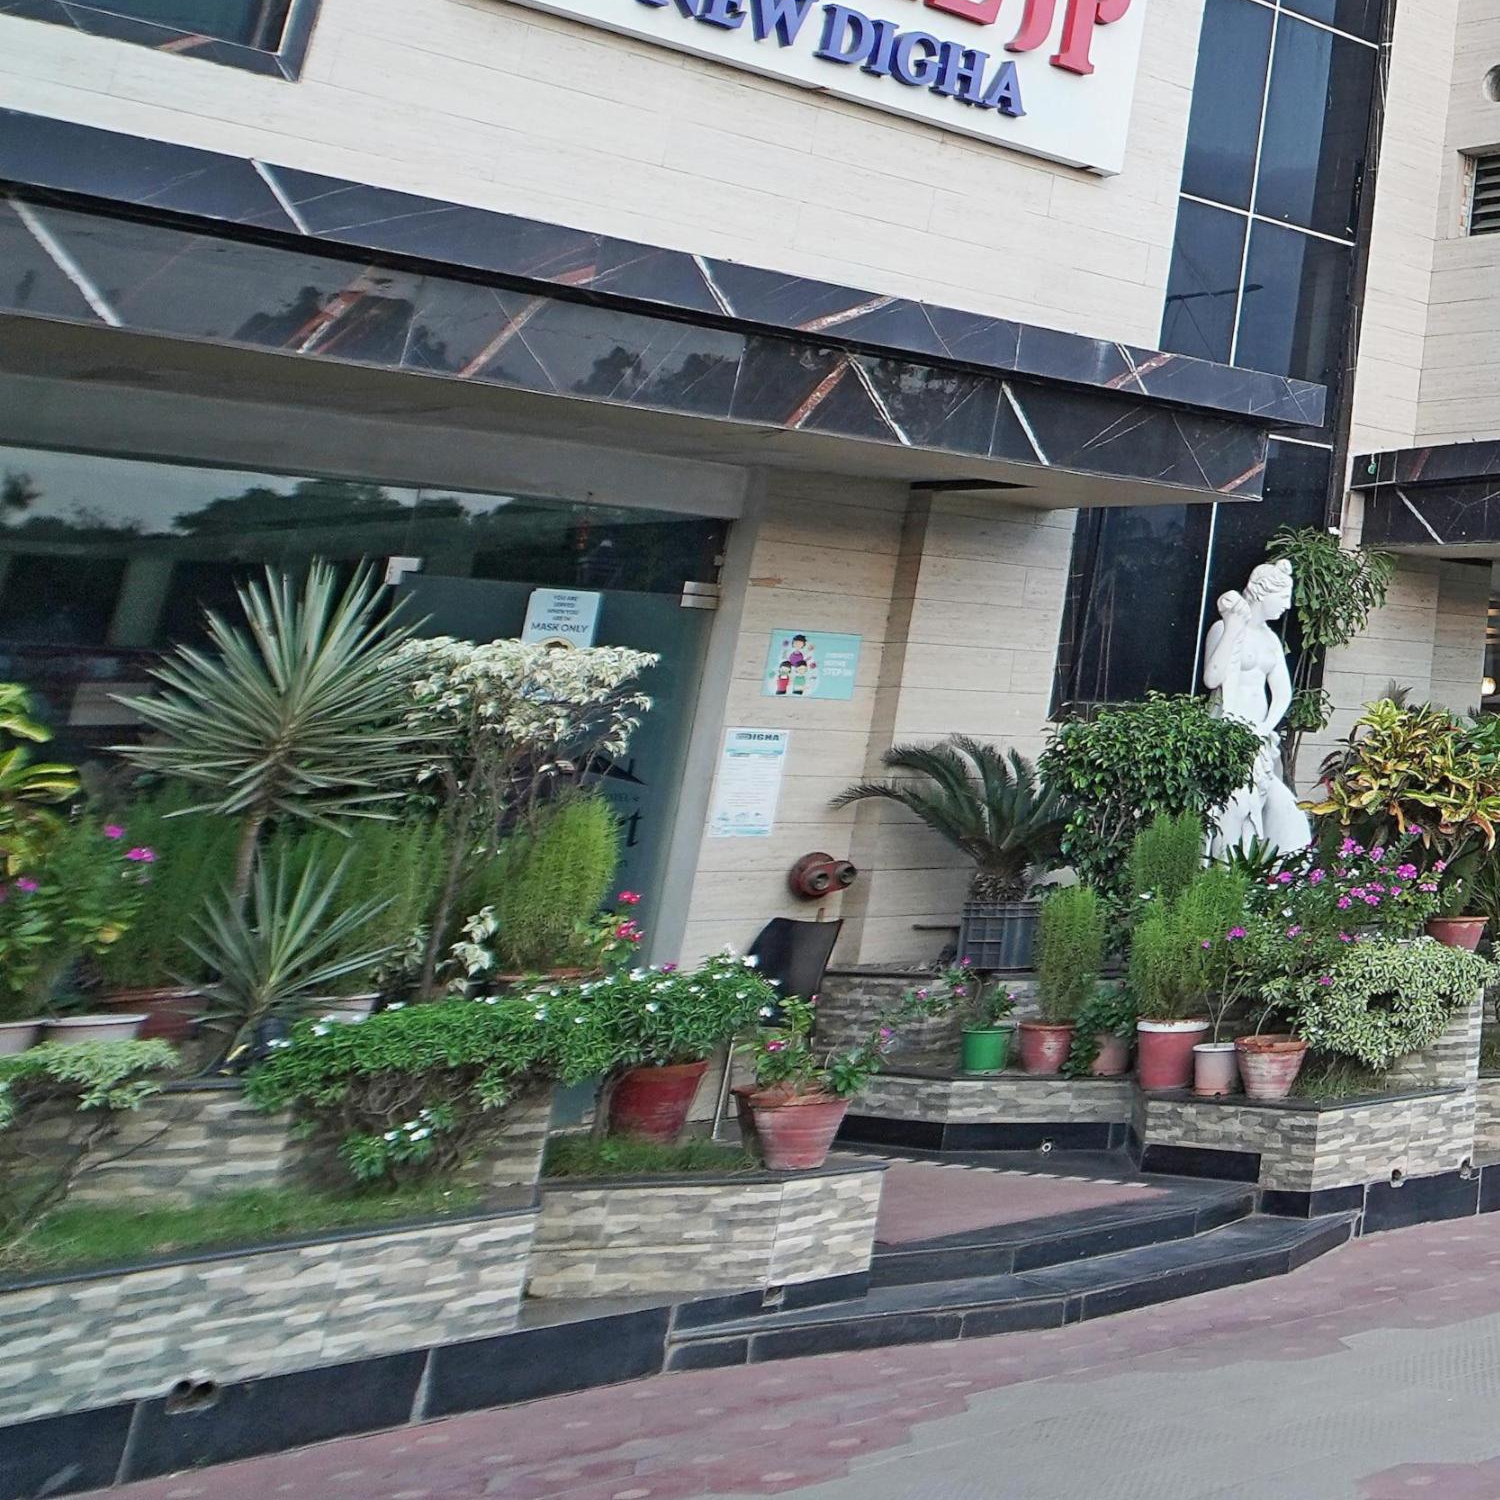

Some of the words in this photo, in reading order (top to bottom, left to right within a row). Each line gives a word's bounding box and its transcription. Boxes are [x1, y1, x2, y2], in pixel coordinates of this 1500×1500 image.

[813, 3, 1026, 119] DIGHA
[530, 622, 560, 632] MASK
[560, 624, 589, 633] ONLY
